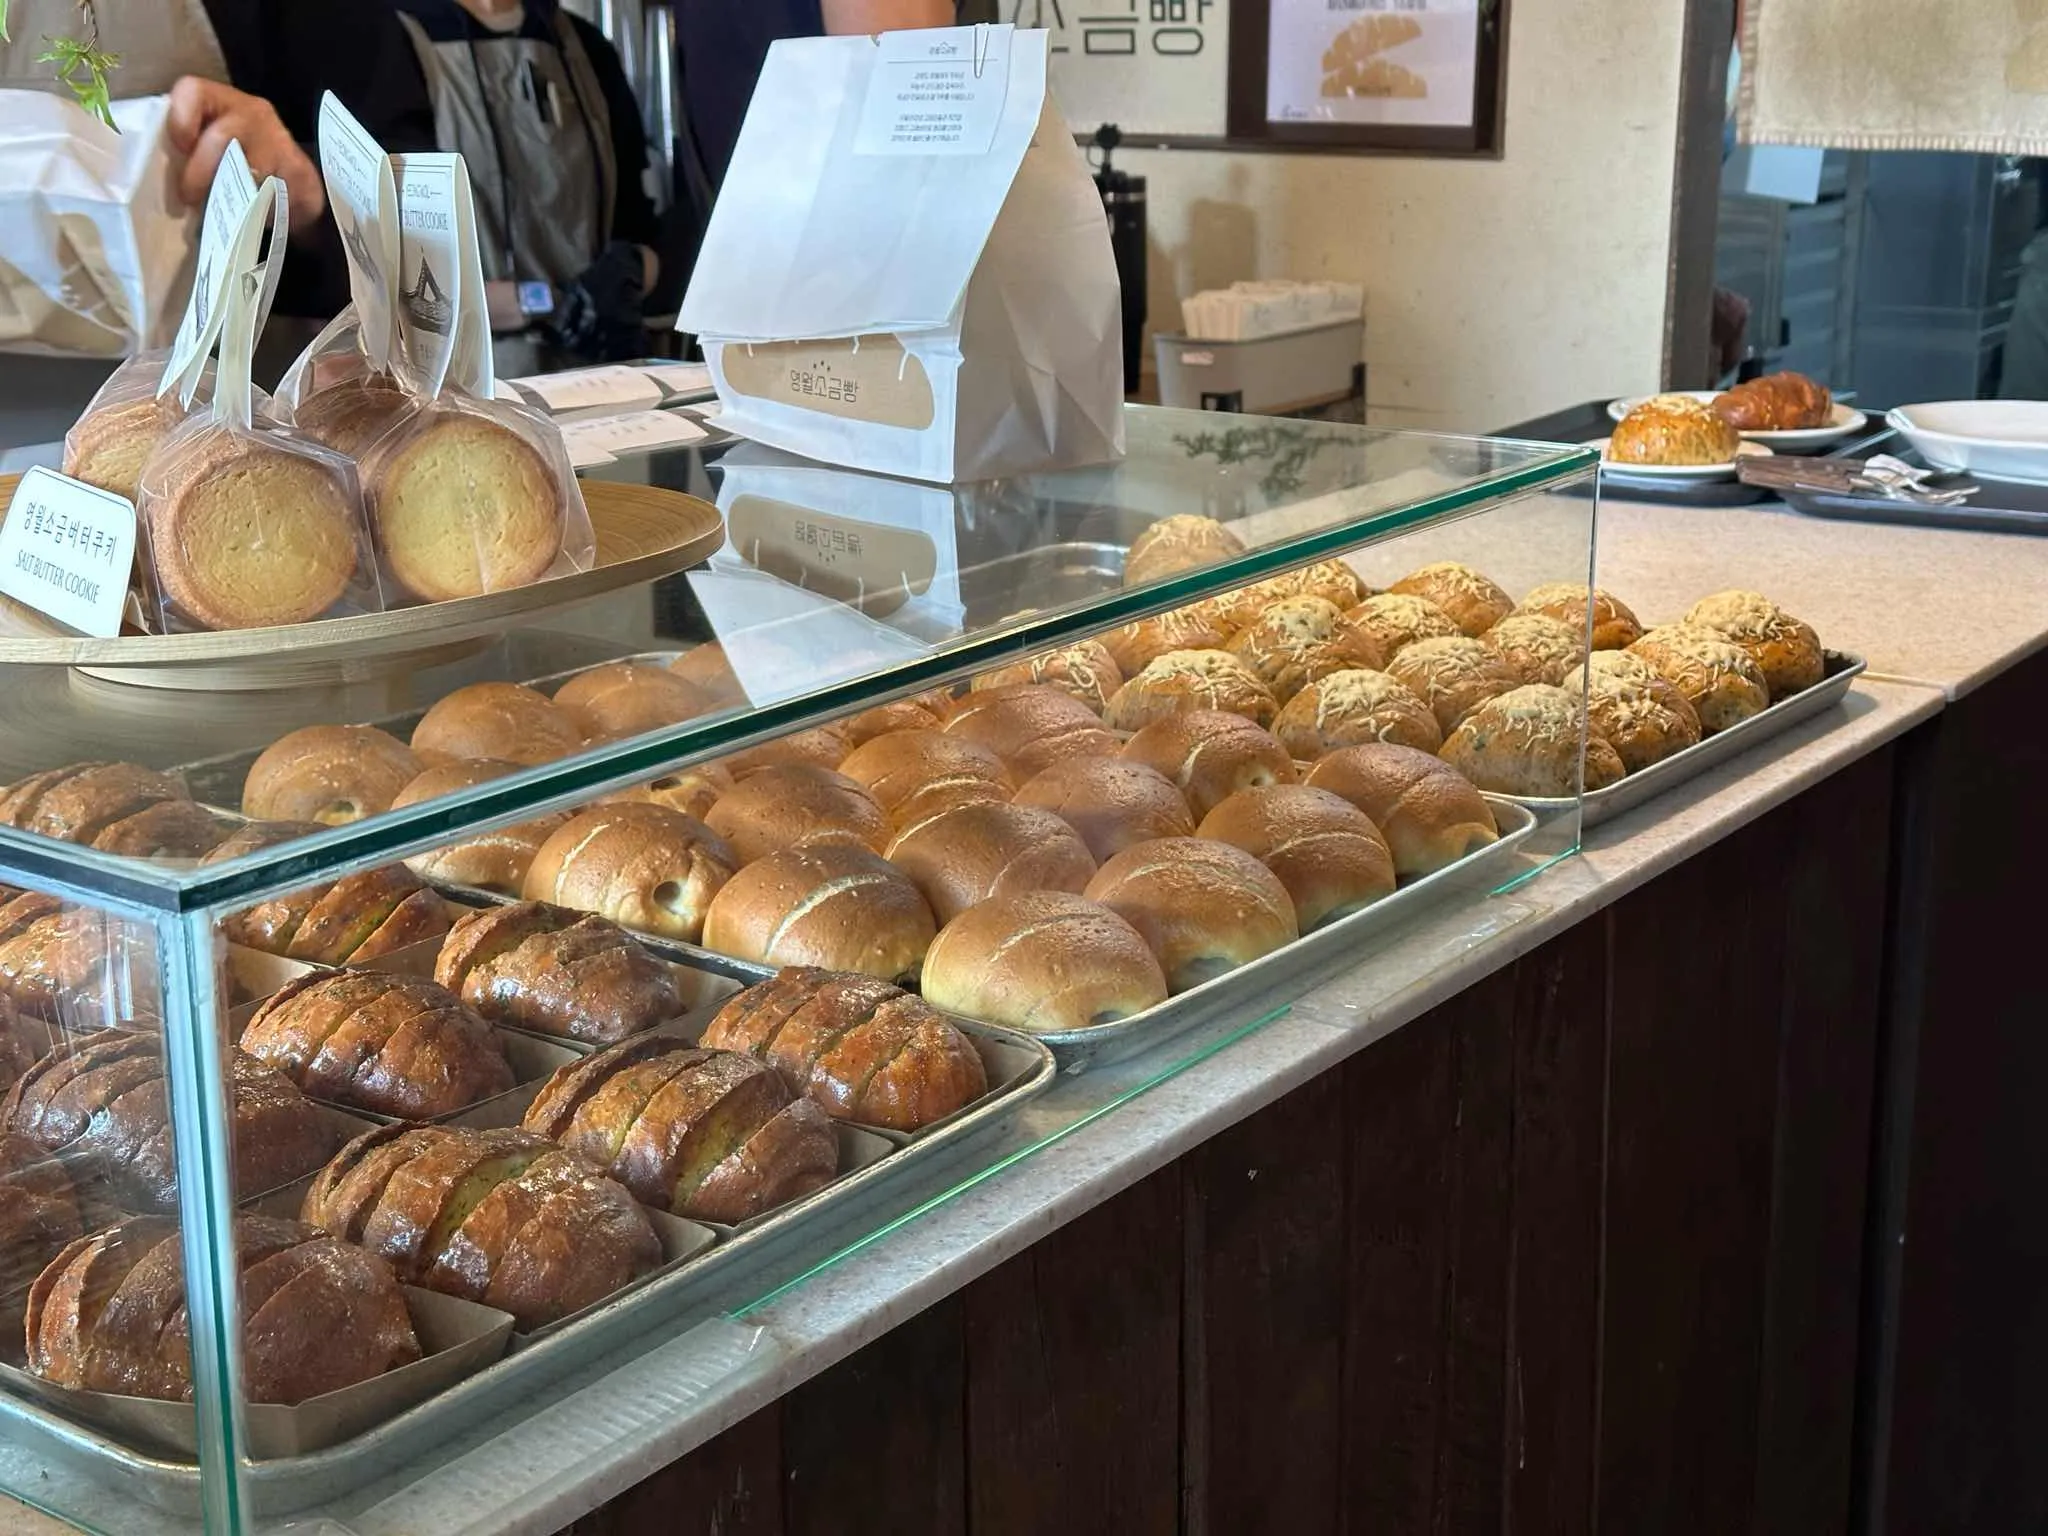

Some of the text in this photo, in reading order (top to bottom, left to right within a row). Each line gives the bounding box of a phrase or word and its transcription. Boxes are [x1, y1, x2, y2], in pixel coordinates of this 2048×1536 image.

[424, 210, 448, 230] COOKIE
[790, 369, 859, 403] 영월소금빵
[24, 502, 117, 567] 영월소금버터쿠키
[16, 549, 100, 604] SALT BUTTER COOKIE
